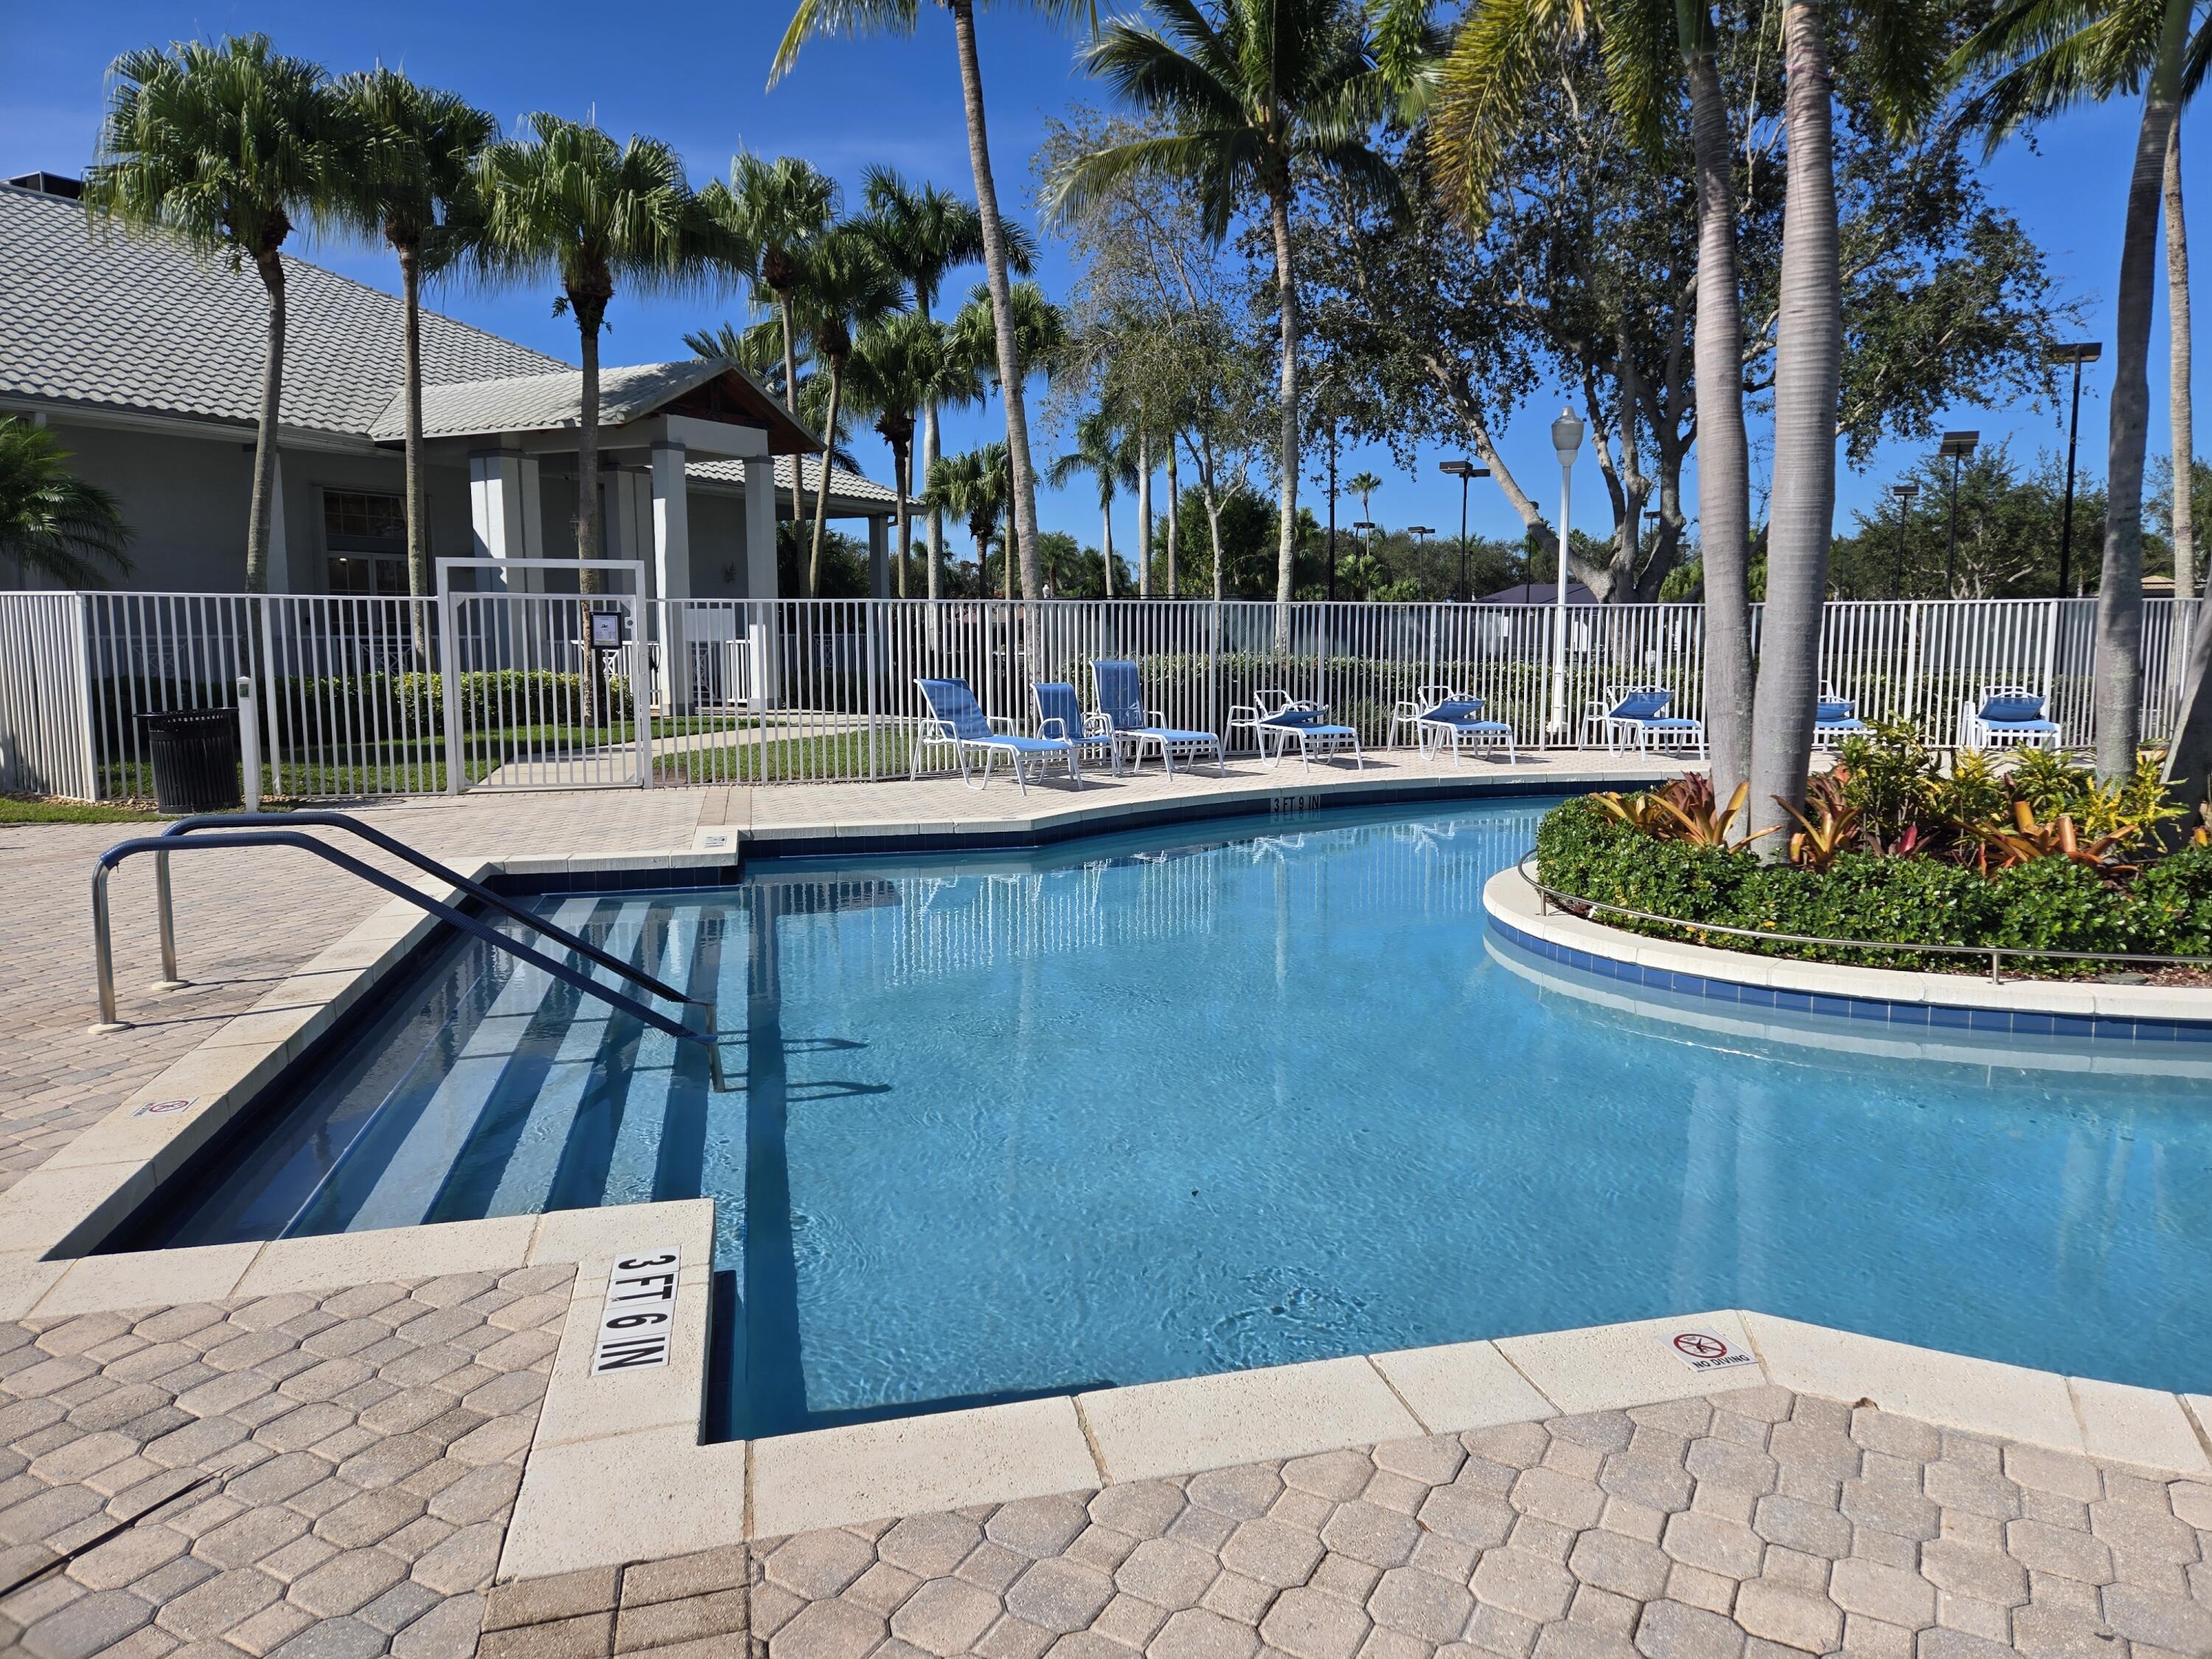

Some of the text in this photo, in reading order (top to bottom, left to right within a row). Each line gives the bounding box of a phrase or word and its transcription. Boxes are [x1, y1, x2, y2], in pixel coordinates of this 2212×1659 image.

[1274, 795, 1320, 812] 3 FT 9 IN
[598, 1255, 677, 1371] 3 FT 6 IN
[1692, 1354, 1750, 1368] NO DIVING
